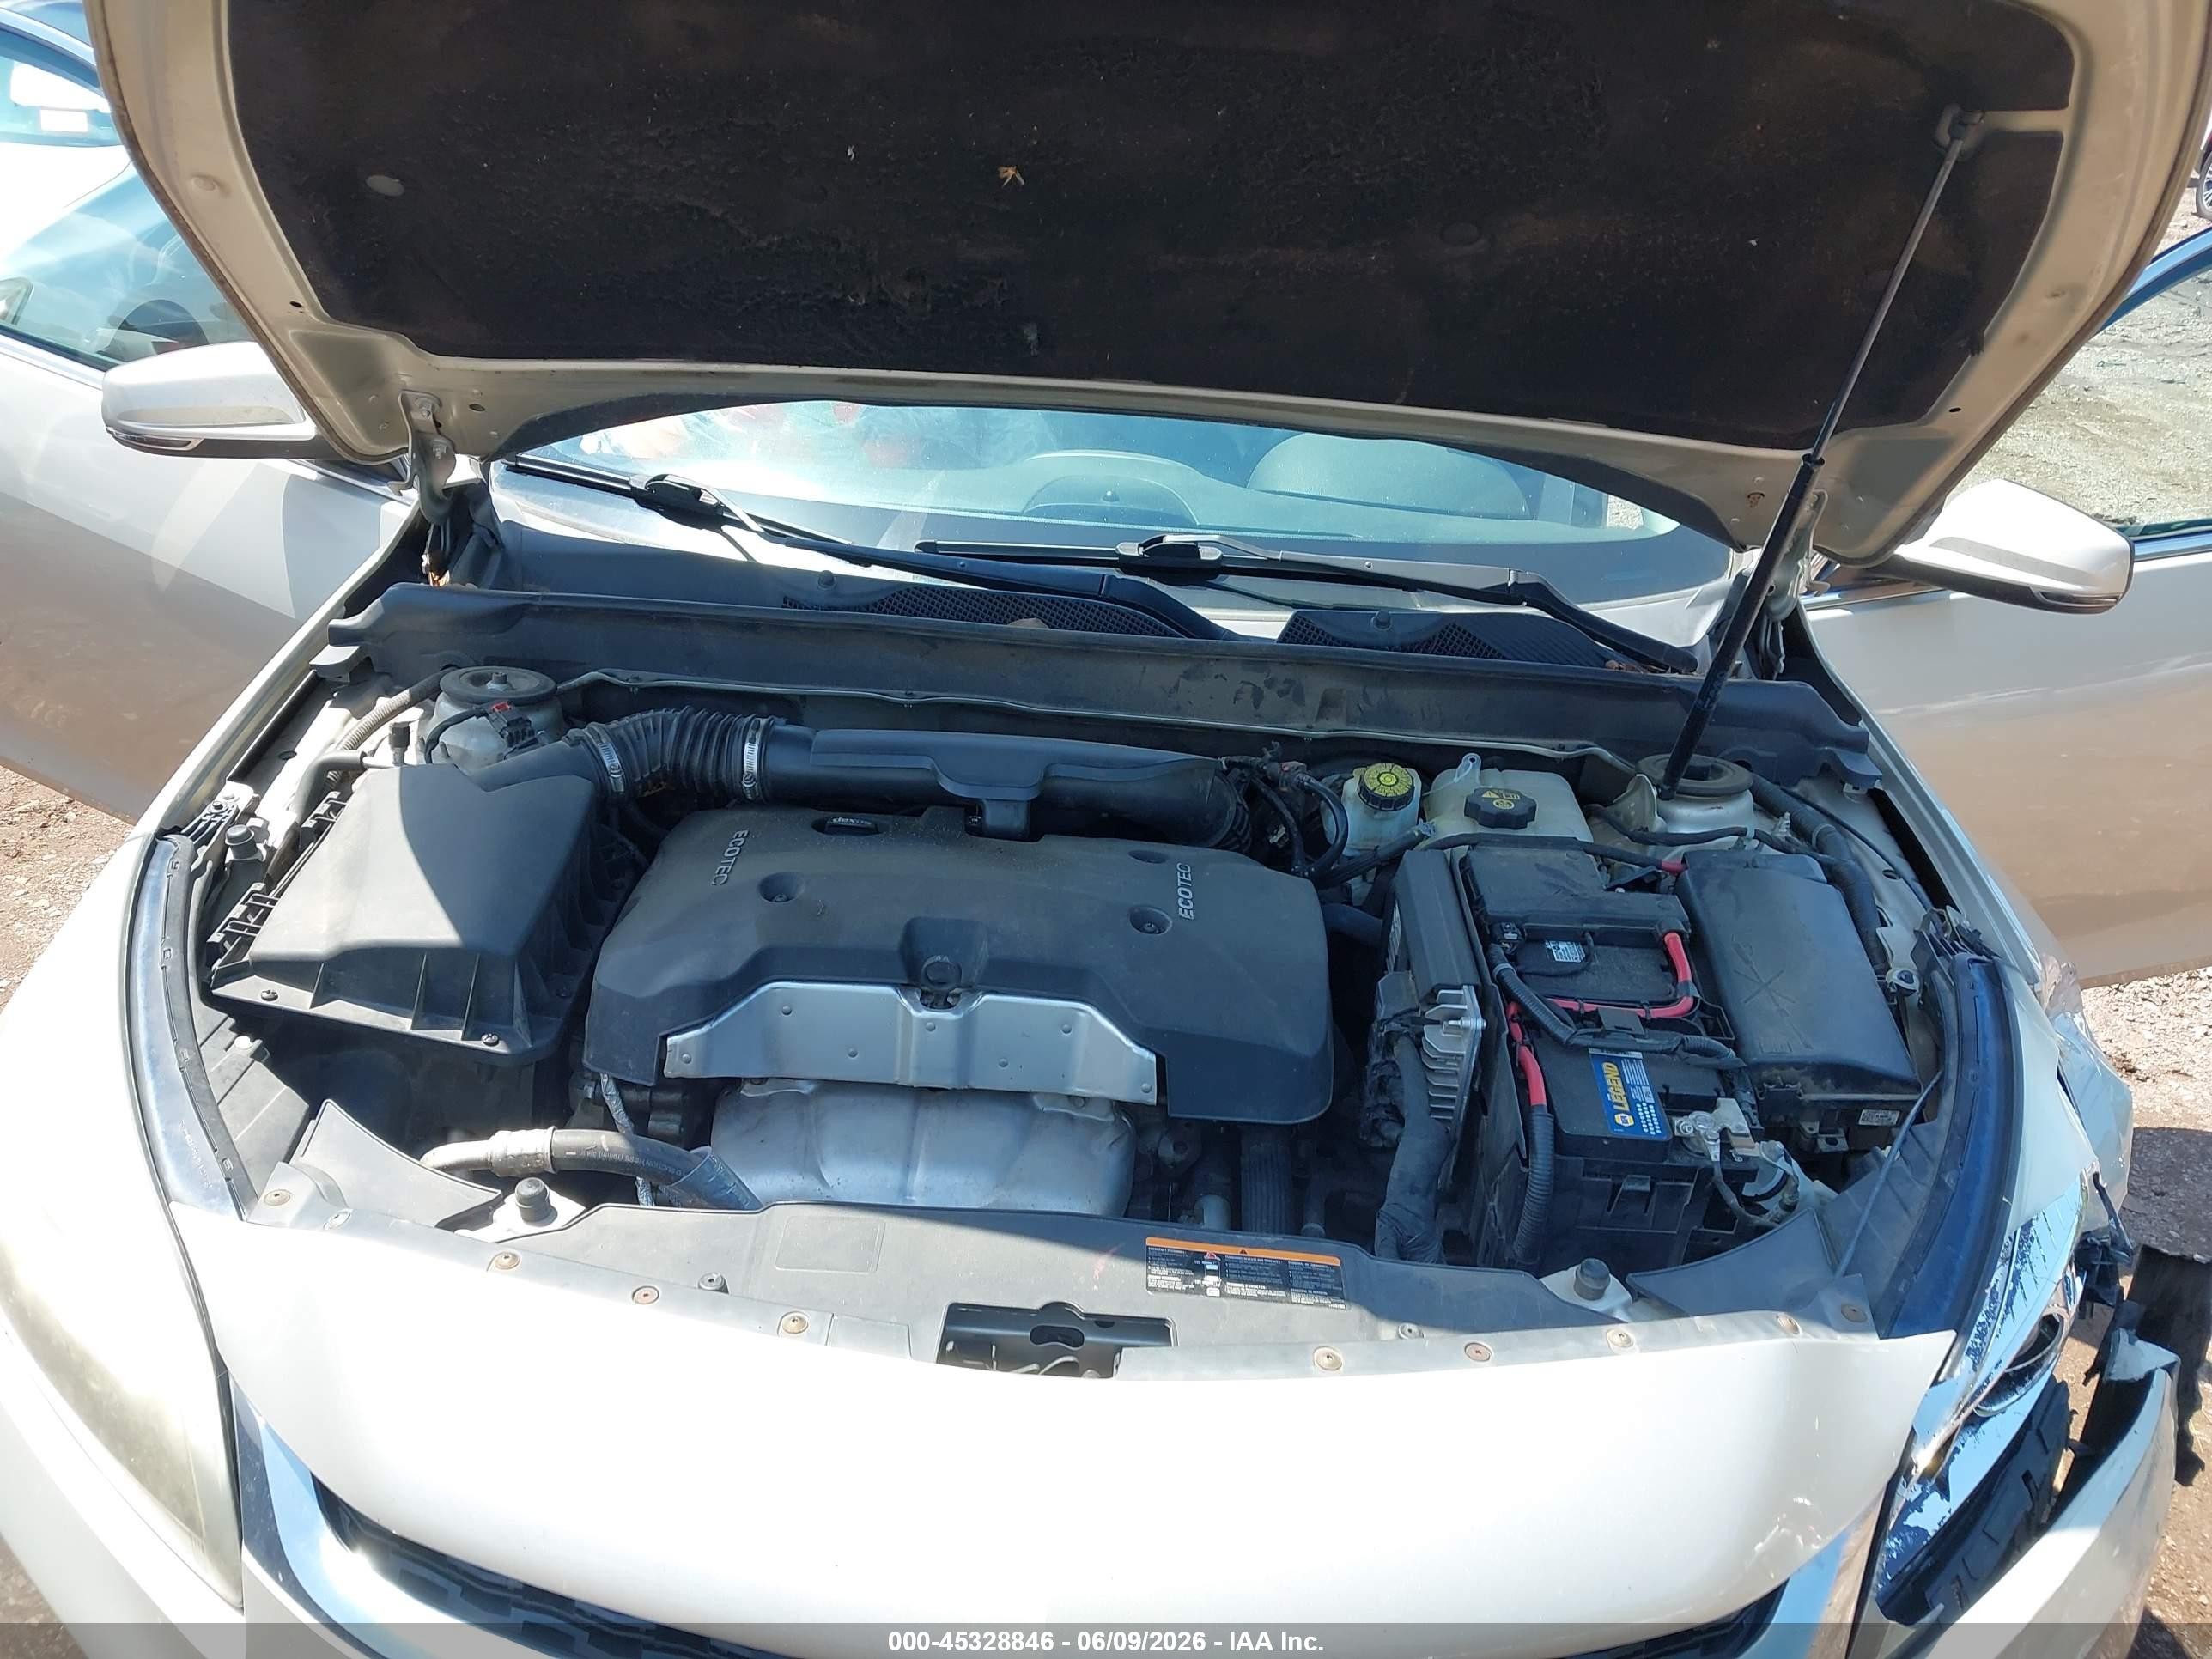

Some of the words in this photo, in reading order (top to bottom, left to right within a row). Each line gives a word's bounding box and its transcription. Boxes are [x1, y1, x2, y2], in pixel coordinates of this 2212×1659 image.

[711, 830, 750, 886] ECOTEC
[1176, 862, 1194, 920] ECOTEC
[1601, 1061, 1630, 1111] LEGEND
